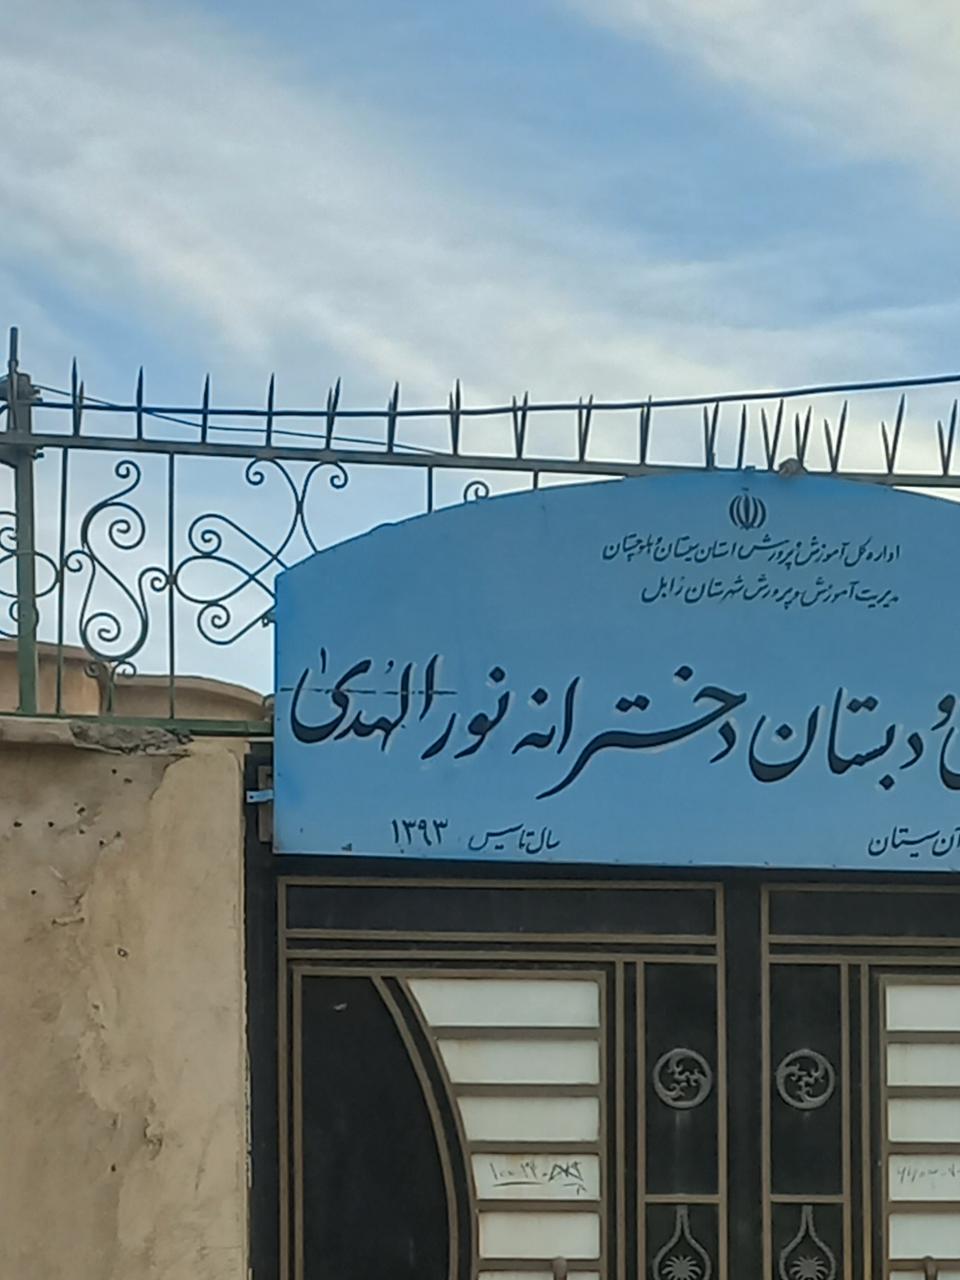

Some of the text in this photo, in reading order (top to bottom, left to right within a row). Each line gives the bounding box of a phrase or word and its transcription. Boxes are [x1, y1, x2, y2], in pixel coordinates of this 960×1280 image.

[602, 533, 653, 562] بلوچستان
[653, 535, 700, 562] سیستان
[694, 541, 737, 563] استان
[738, 533, 795, 571] پرورش
[795, 536, 851, 566] آموزش
[844, 536, 873, 567] کل
[866, 544, 900, 563] اداره
[641, 576, 685, 603] زابل
[684, 574, 745, 603] شهرستان
[743, 574, 794, 610] پرورش
[800, 577, 860, 607] آموزش
[512, 664, 748, 801] دخترانه
[748, 686, 924, 791] دبستان
[391, 818, 449, 847] ۱۳۹۳
[525, 826, 561, 854] سال
[868, 826, 940, 858] سیستان
